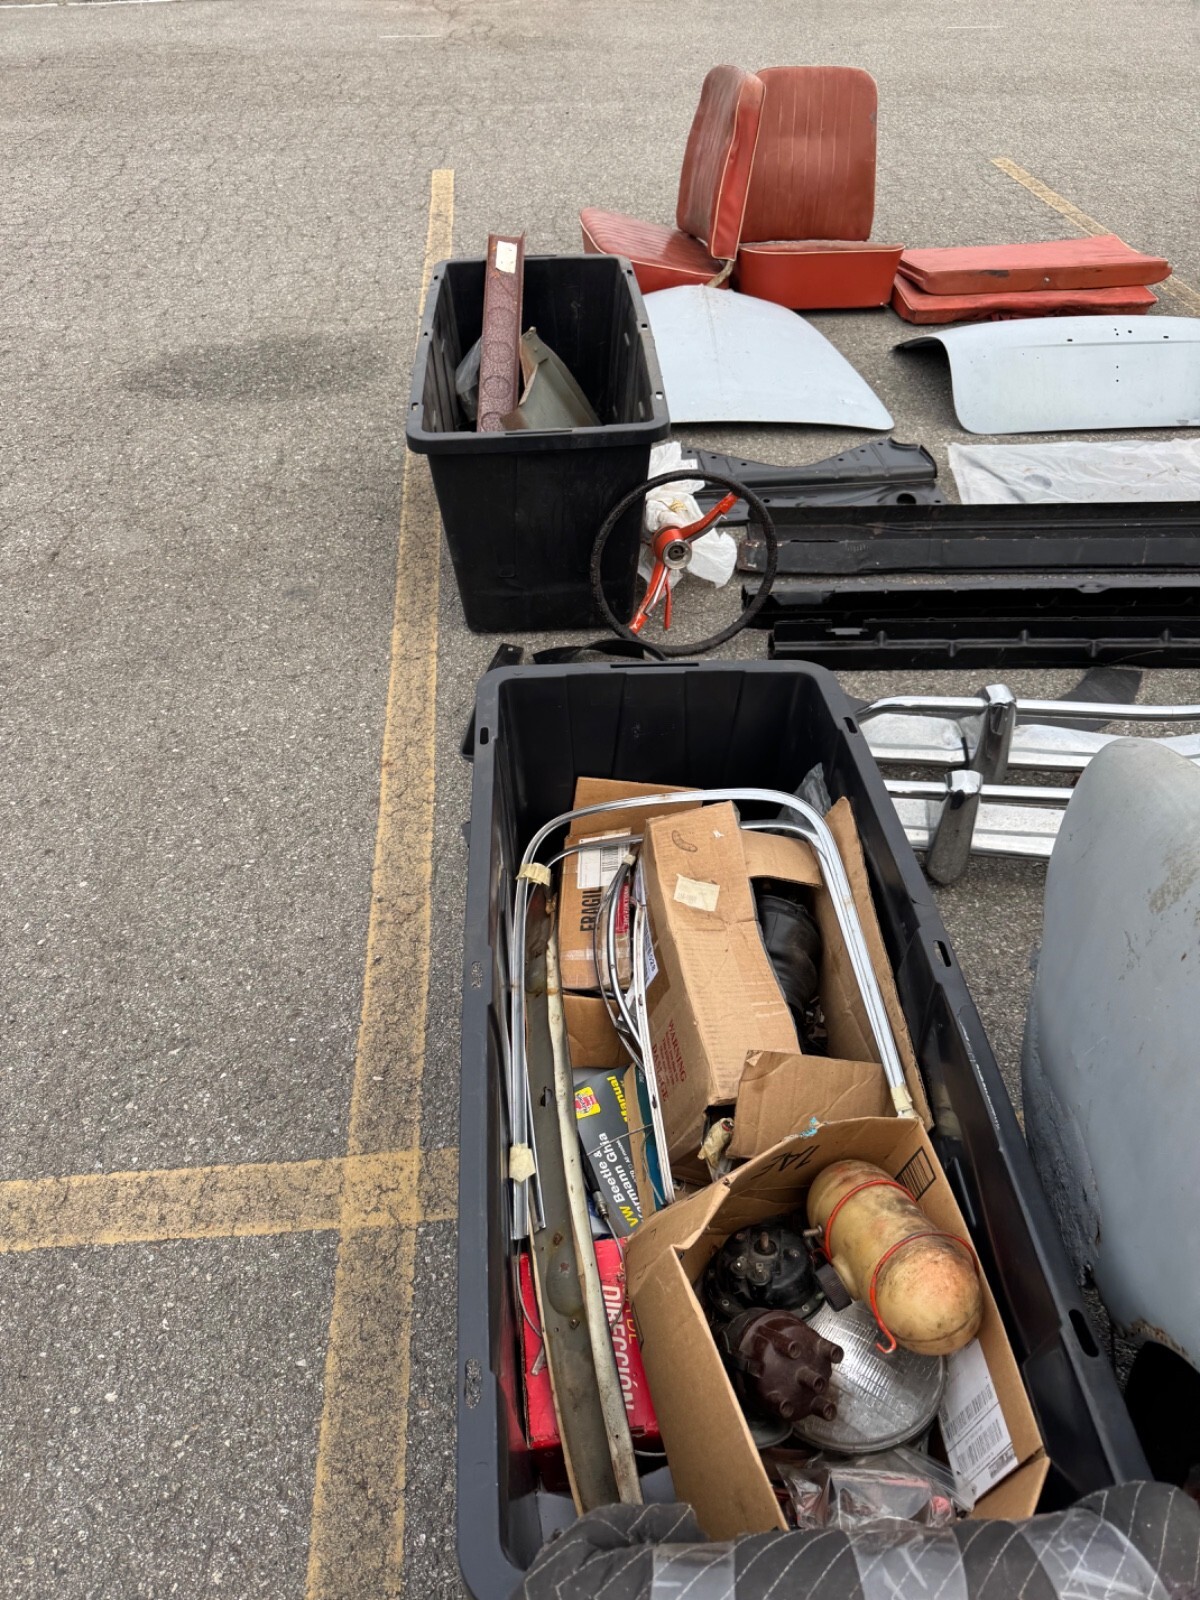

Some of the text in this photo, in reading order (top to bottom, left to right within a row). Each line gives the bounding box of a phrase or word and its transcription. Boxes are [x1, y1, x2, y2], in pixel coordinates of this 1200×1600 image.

[668, 1019, 687, 1082] WARNING
[599, 1132, 618, 1163] Ghia
[593, 1150, 639, 1228] VW Beetle &
